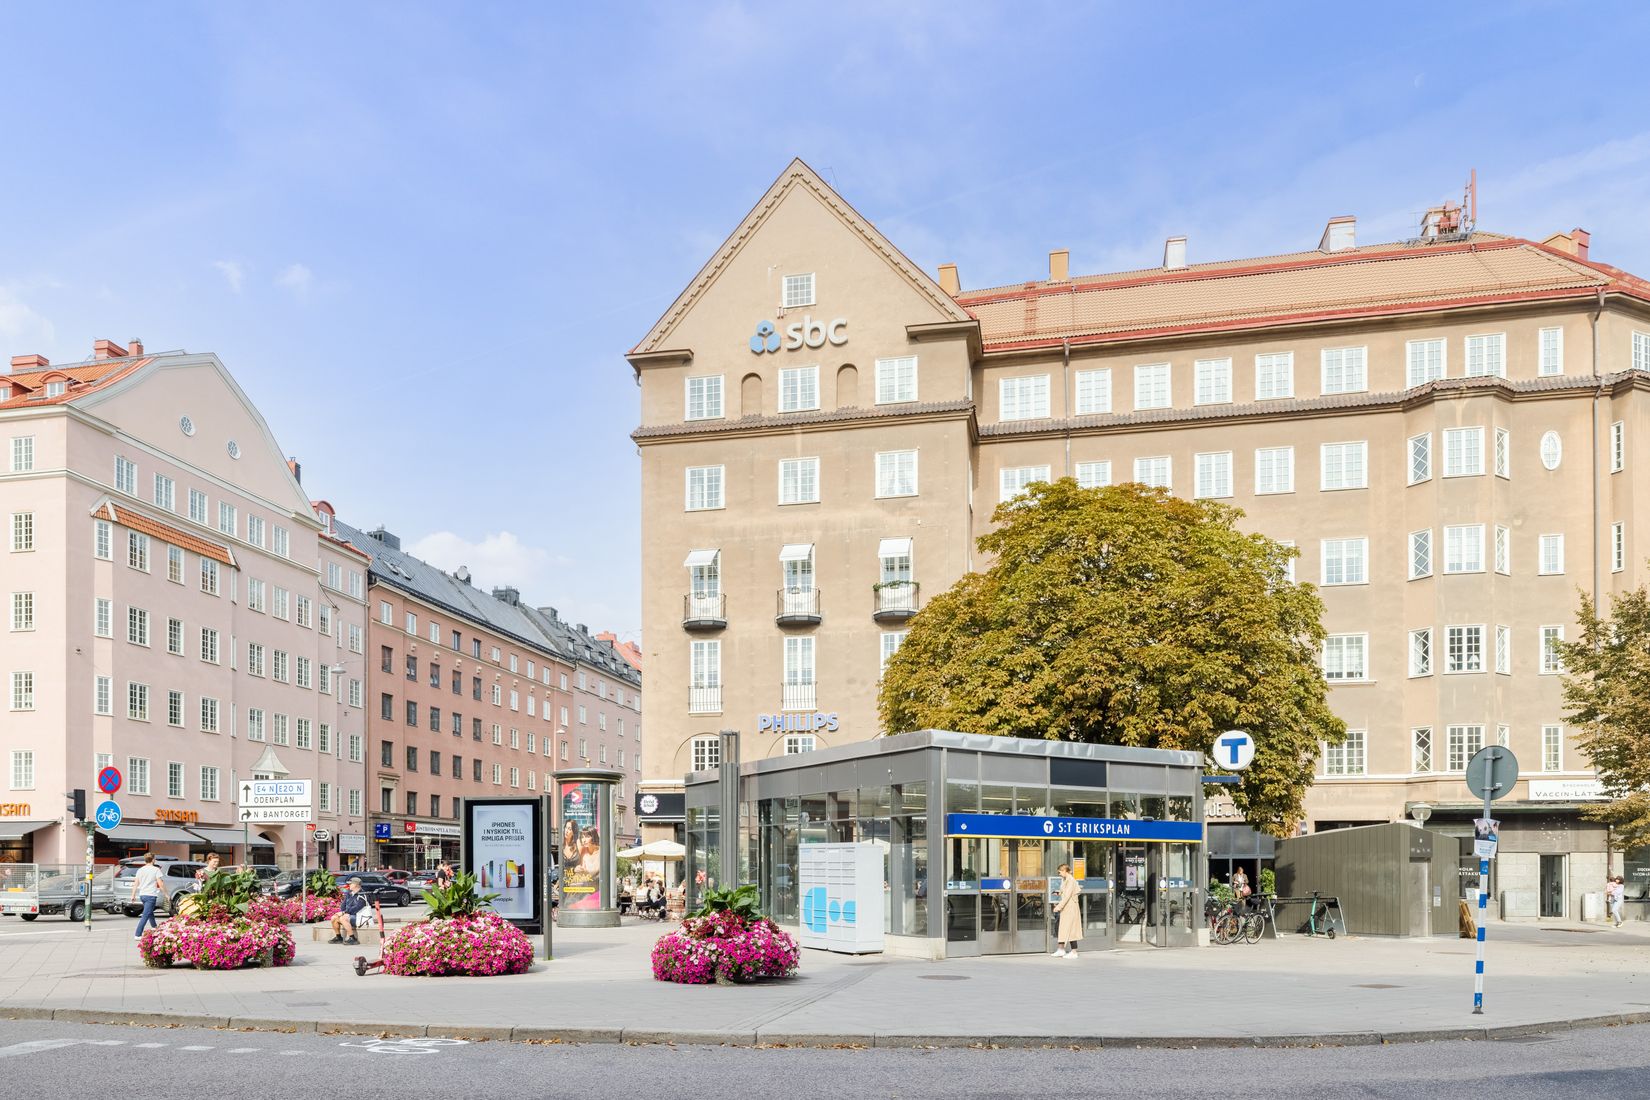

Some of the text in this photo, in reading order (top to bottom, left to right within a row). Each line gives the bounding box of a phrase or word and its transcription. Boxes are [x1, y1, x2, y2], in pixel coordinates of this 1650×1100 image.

[785, 315, 848, 350] sbc
[758, 712, 839, 733] PHILIPS
[1221, 737, 1247, 764] T
[1058, 822, 1130, 835] S:T ERIKSPLAN
